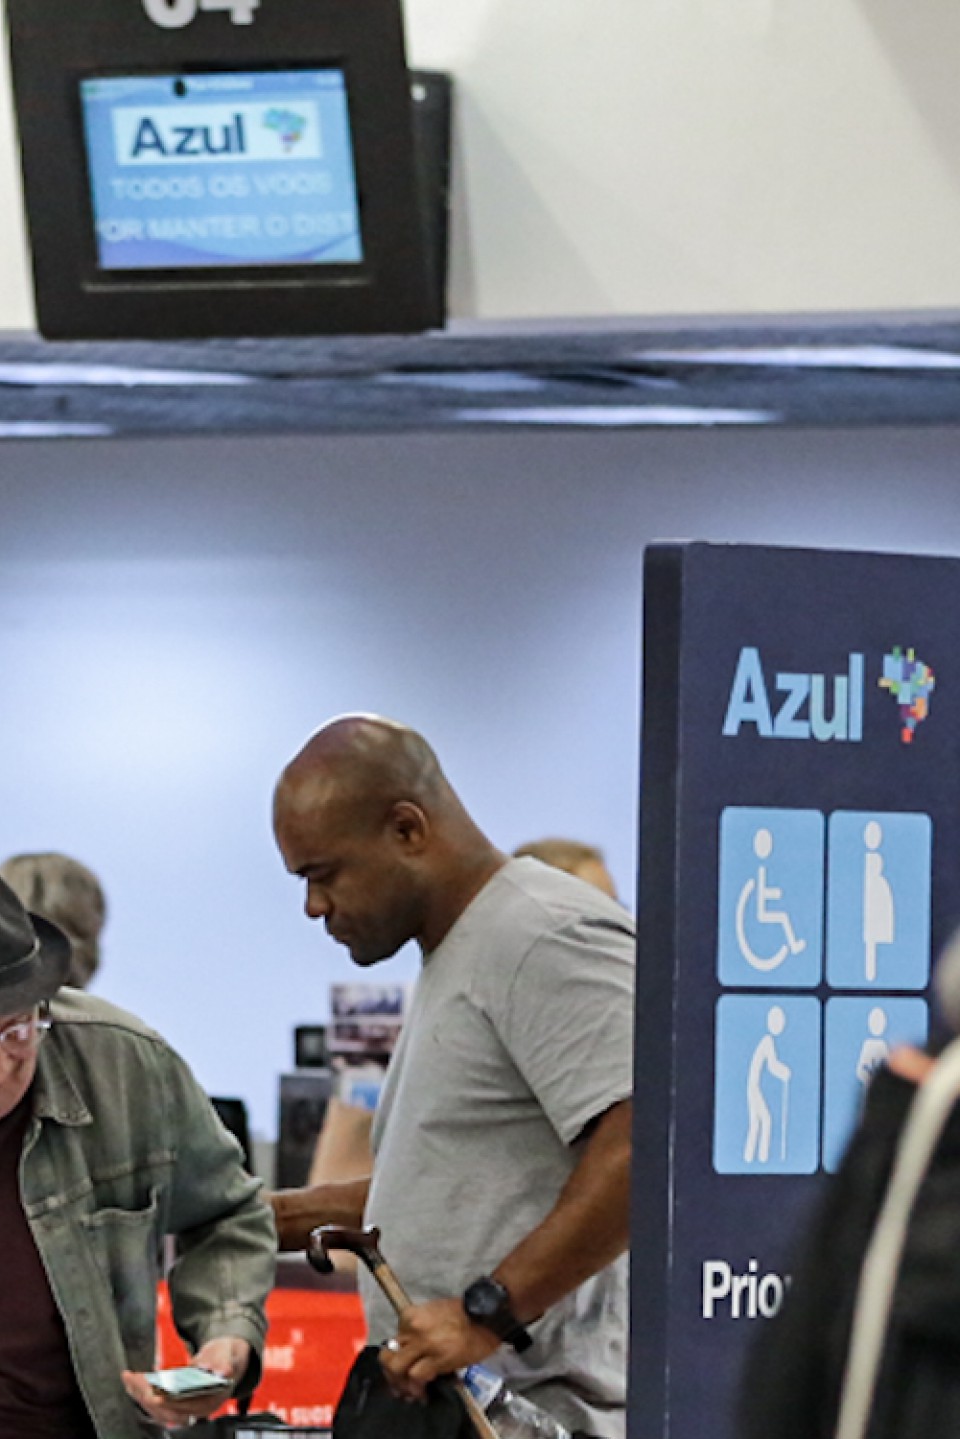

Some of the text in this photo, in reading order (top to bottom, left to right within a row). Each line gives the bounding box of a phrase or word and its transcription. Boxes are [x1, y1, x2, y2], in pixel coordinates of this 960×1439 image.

[131, 113, 246, 158] Azul
[722, 646, 864, 743] Azul
[702, 1258, 792, 1319] Prio
